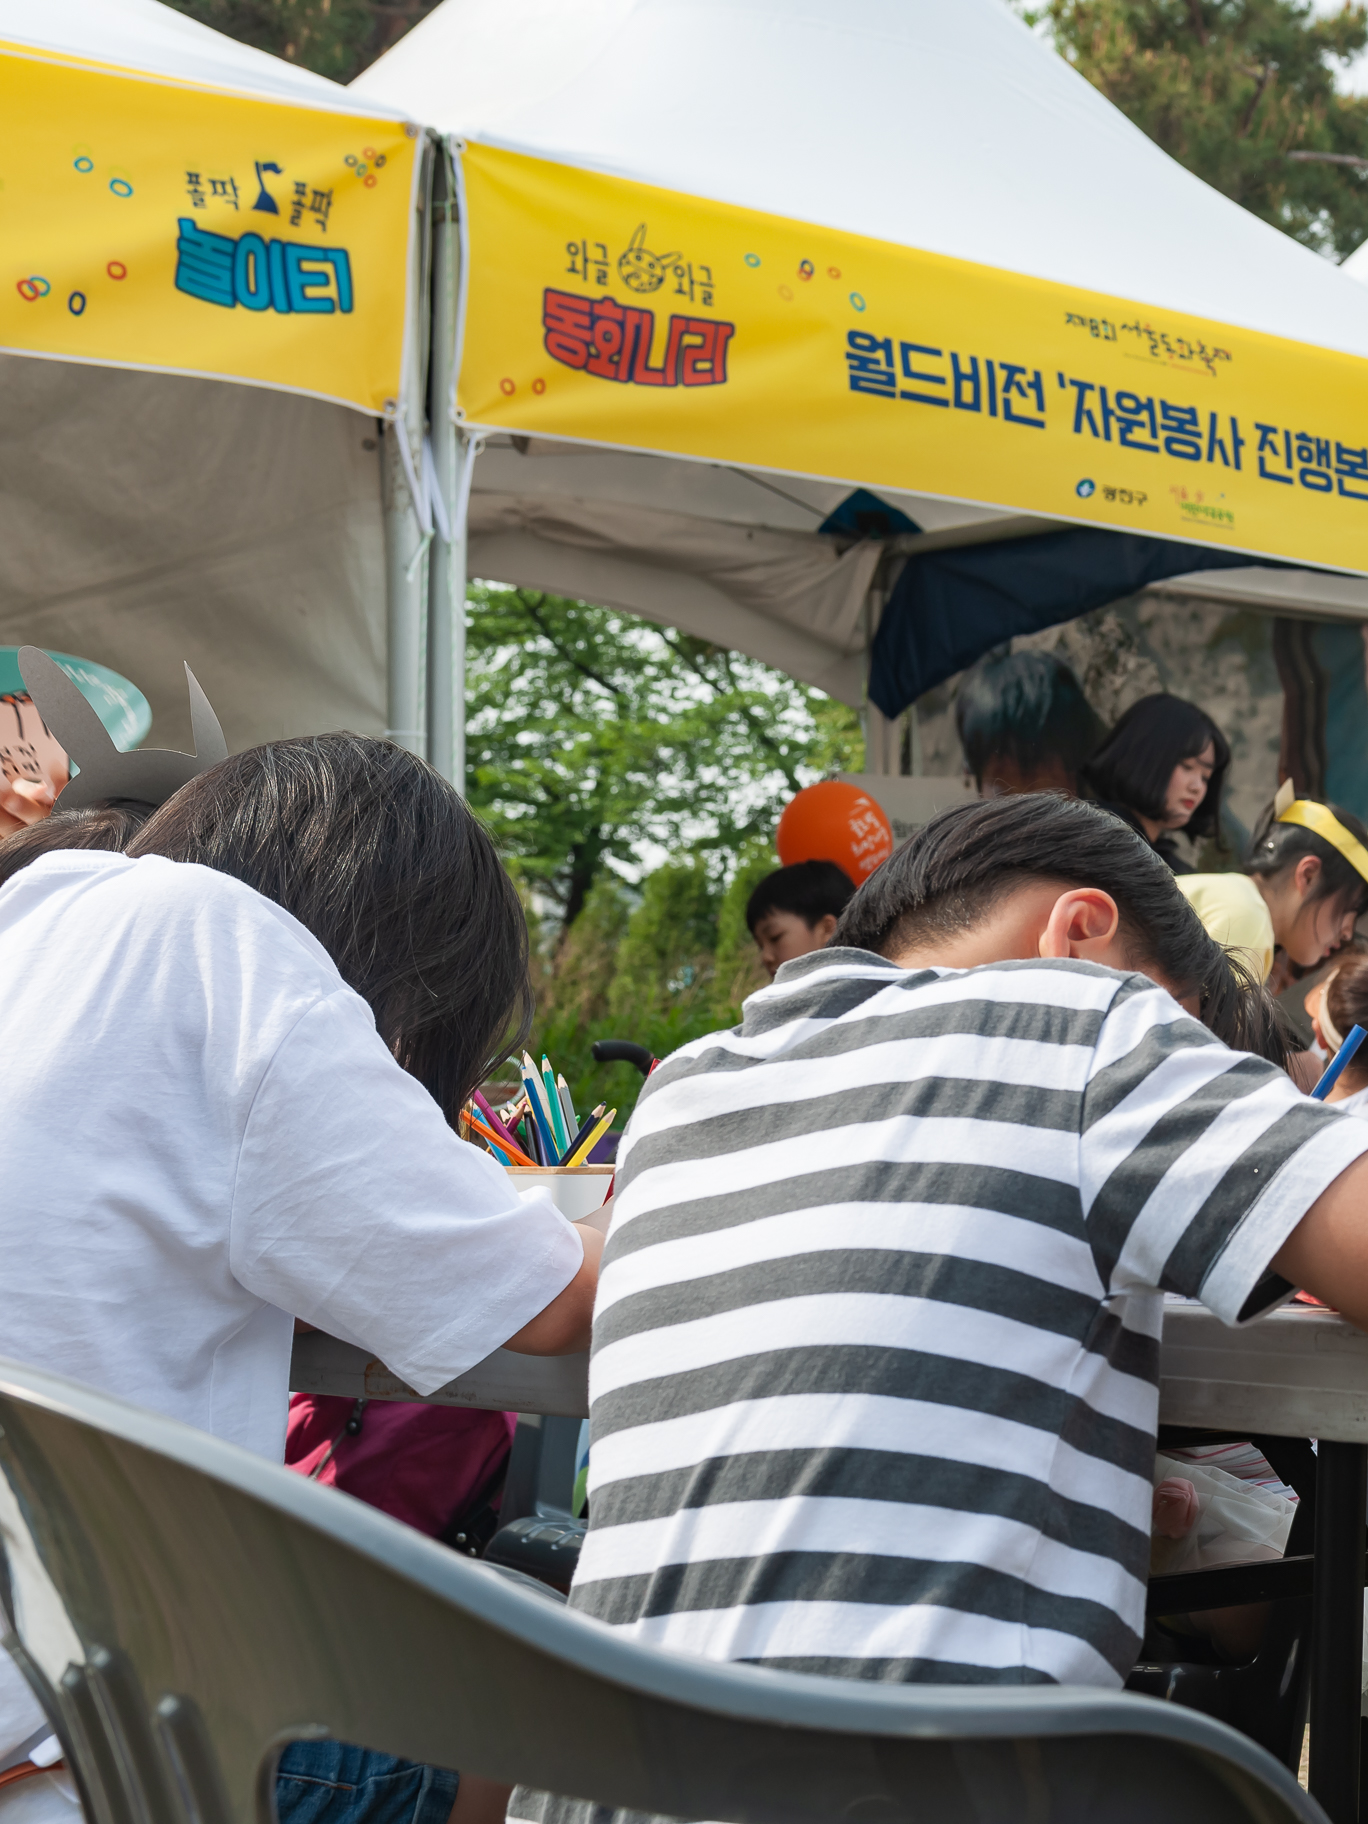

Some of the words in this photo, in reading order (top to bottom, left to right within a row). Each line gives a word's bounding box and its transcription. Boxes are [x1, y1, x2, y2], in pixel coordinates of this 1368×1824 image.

[174, 216, 354, 315] 놀이터
[565, 237, 610, 286] 와글
[672, 260, 715, 307] 와글
[542, 286, 736, 388] 동화나라
[1065, 311, 1118, 343] 제8회
[845, 329, 1046, 430] 월드비전
[1056, 370, 1246, 472] '자원봉사
